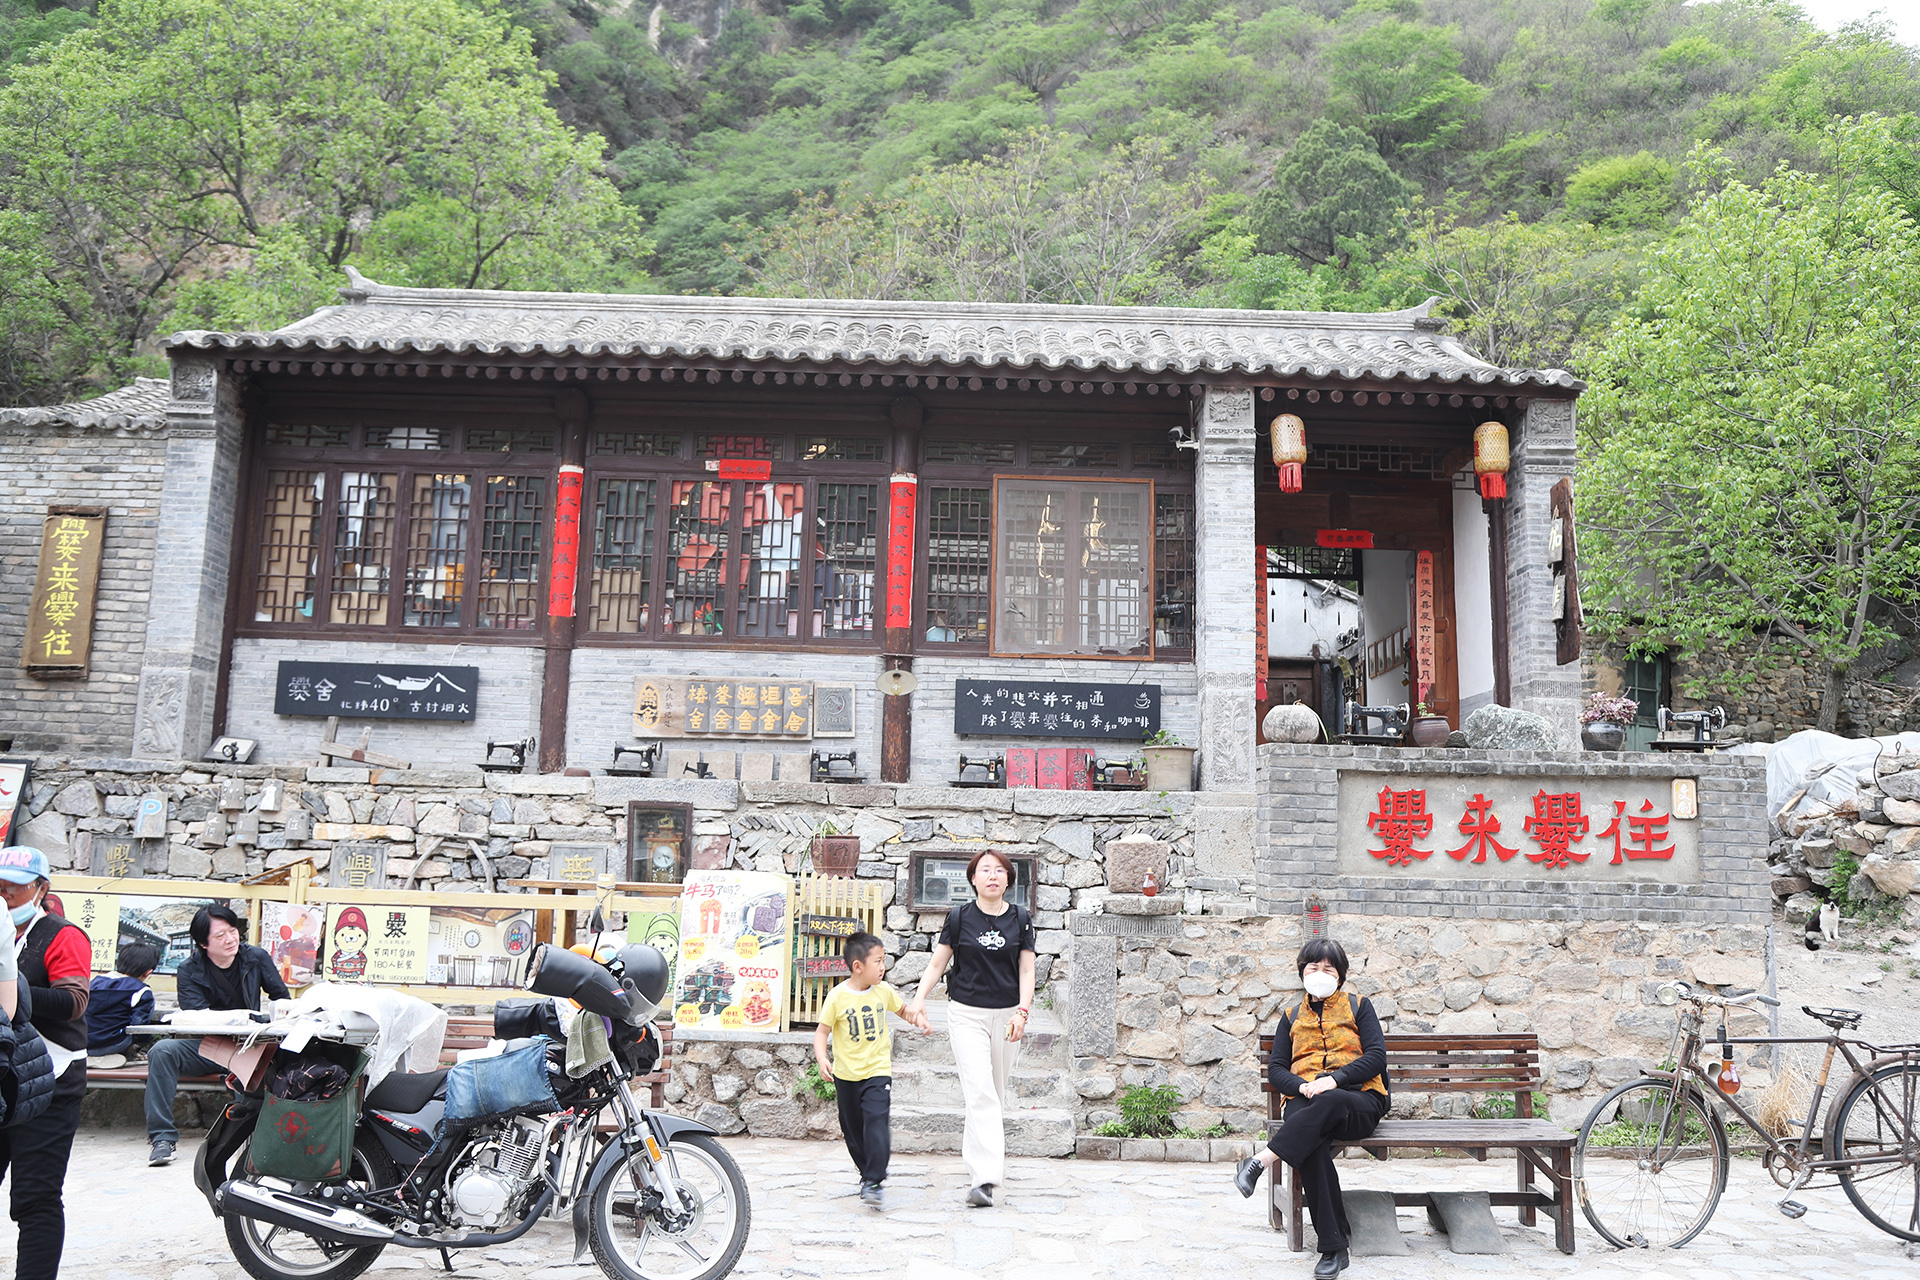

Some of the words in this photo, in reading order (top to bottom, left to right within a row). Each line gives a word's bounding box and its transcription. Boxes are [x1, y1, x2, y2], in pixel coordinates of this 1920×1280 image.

[288, 676, 338, 702] 爨舍
[966, 688, 1105, 711] 人类的悲欢并不相通
[409, 700, 470, 714] 古村烟火
[1012, 751, 1029, 783] 咖啡
[1041, 754, 1063, 778] 茶
[138, 799, 162, 832] P
[1366, 785, 1676, 869] 爨来爨往
[810, 920, 856, 936] 双人下午茶
